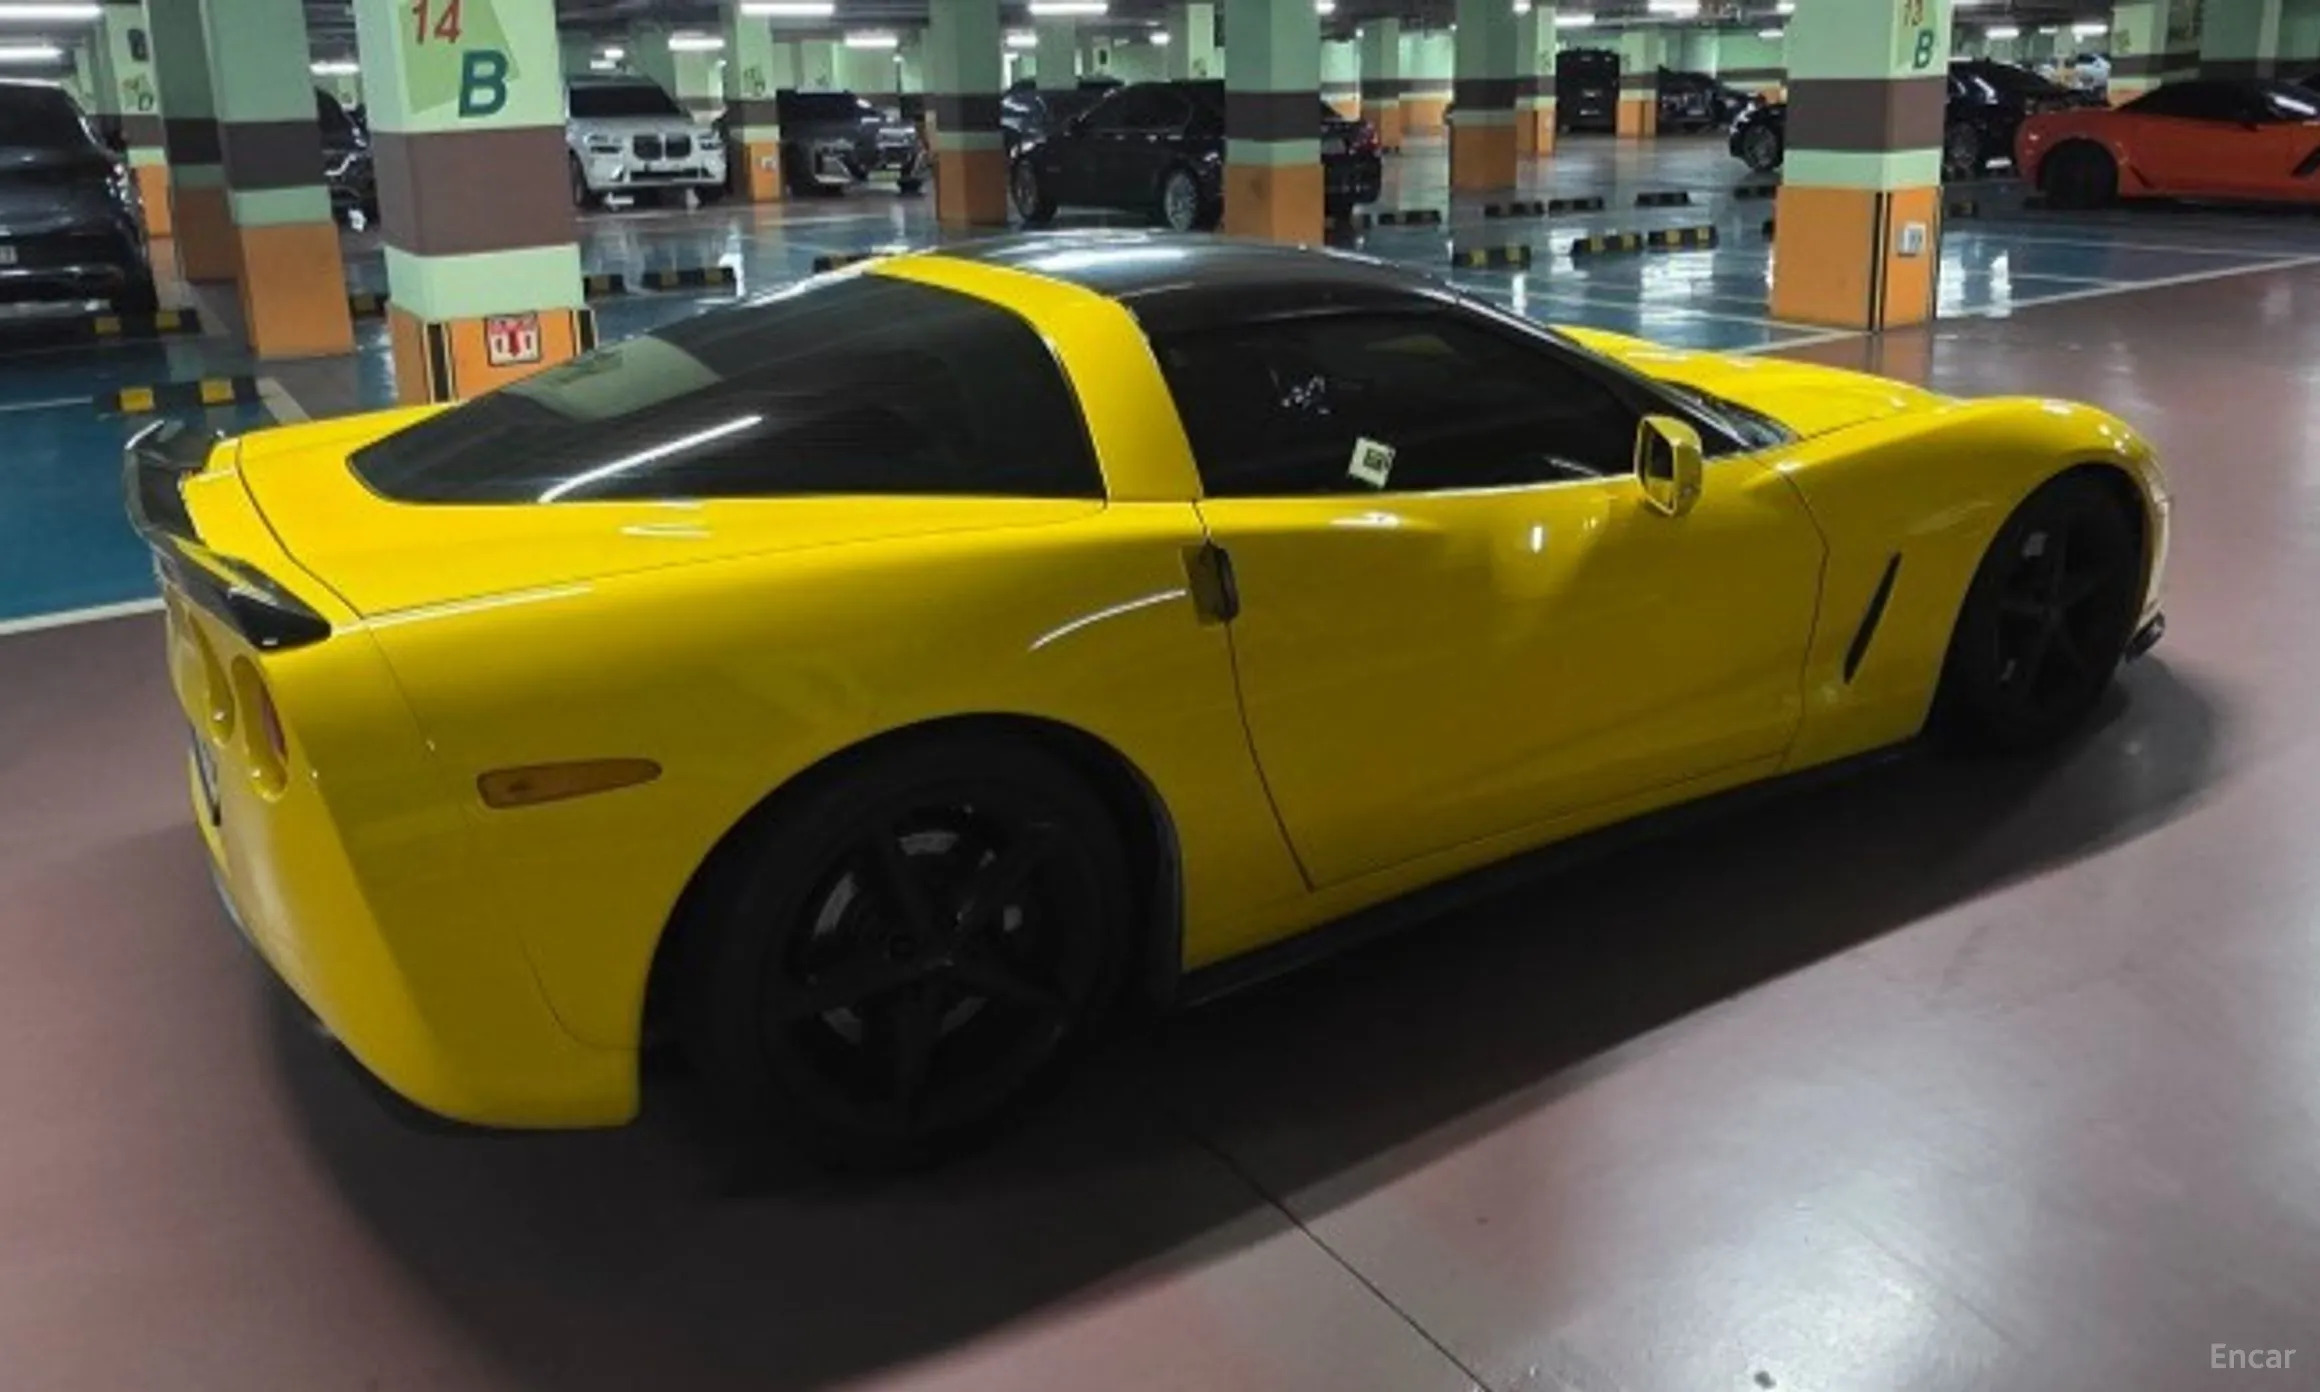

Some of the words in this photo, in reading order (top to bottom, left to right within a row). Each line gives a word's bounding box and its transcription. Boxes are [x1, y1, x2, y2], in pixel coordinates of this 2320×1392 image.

[412, 0, 461, 44] 14
[1912, 29, 1934, 70] B
[458, 50, 508, 118] B
